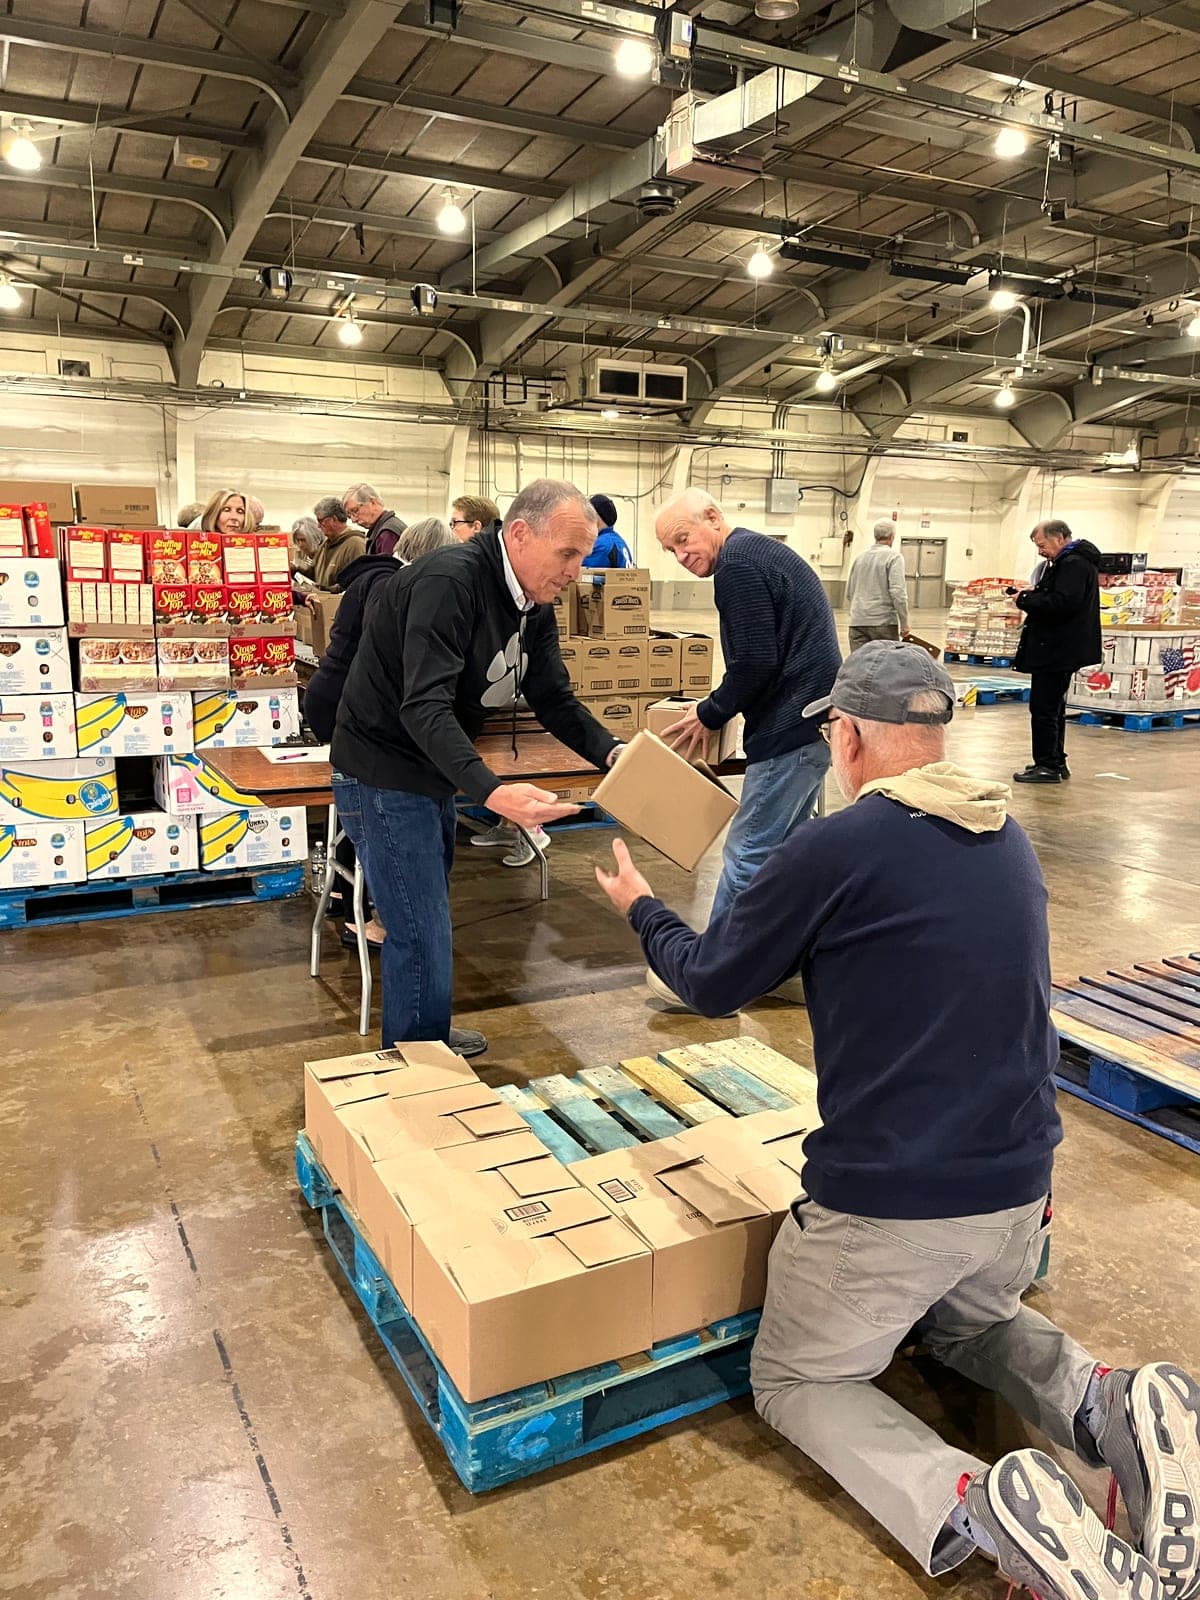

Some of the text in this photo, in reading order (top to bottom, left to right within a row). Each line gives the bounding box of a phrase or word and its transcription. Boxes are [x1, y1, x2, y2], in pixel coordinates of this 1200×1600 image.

[158, 590, 186, 608] Stove
[168, 600, 183, 611] Top
[194, 590, 222, 608] Stove
[205, 600, 219, 611] Top
[229, 590, 255, 609] Stove
[240, 600, 253, 611] Top
[263, 590, 289, 608] Stove
[273, 600, 287, 611] Top
[230, 644, 257, 661] Stove
[264, 642, 290, 660] Stove
[273, 652, 287, 662] Top
[240, 653, 254, 664] Top
